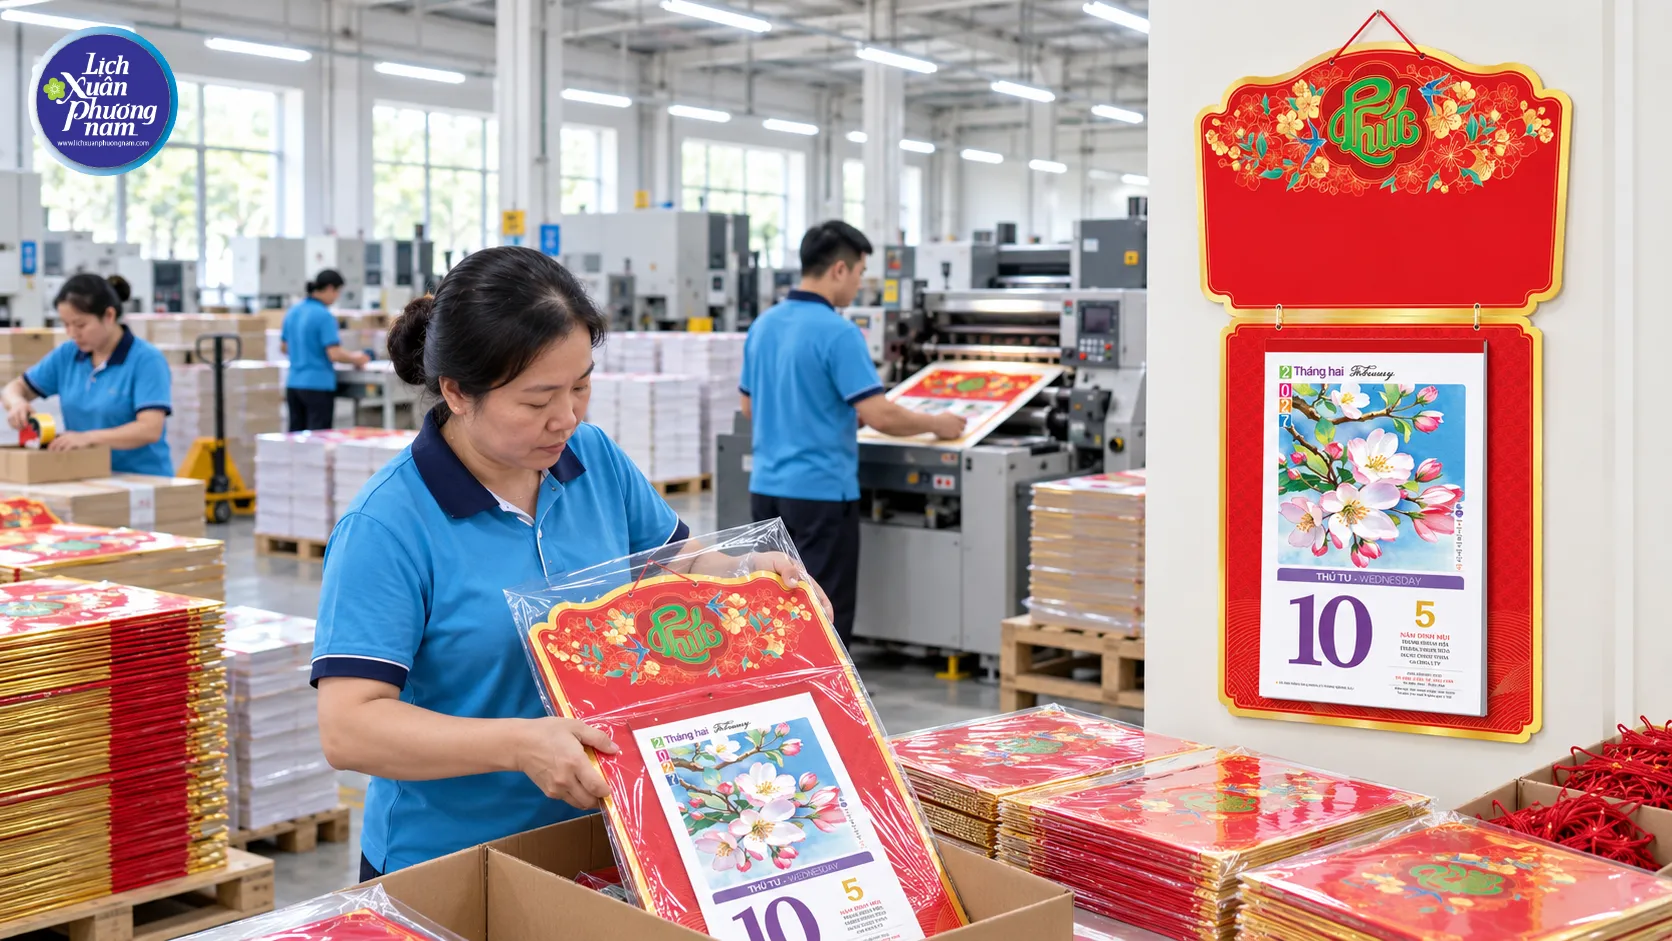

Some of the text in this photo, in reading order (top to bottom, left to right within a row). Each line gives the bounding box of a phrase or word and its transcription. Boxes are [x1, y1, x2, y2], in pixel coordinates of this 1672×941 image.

[1327, 74, 1422, 166] Phúc
[1294, 366, 1326, 379] Tháng
[1328, 366, 1344, 377] hai
[1288, 593, 1436, 668] 10 5
[695, 727, 709, 738] hai
[841, 877, 864, 902] 5
